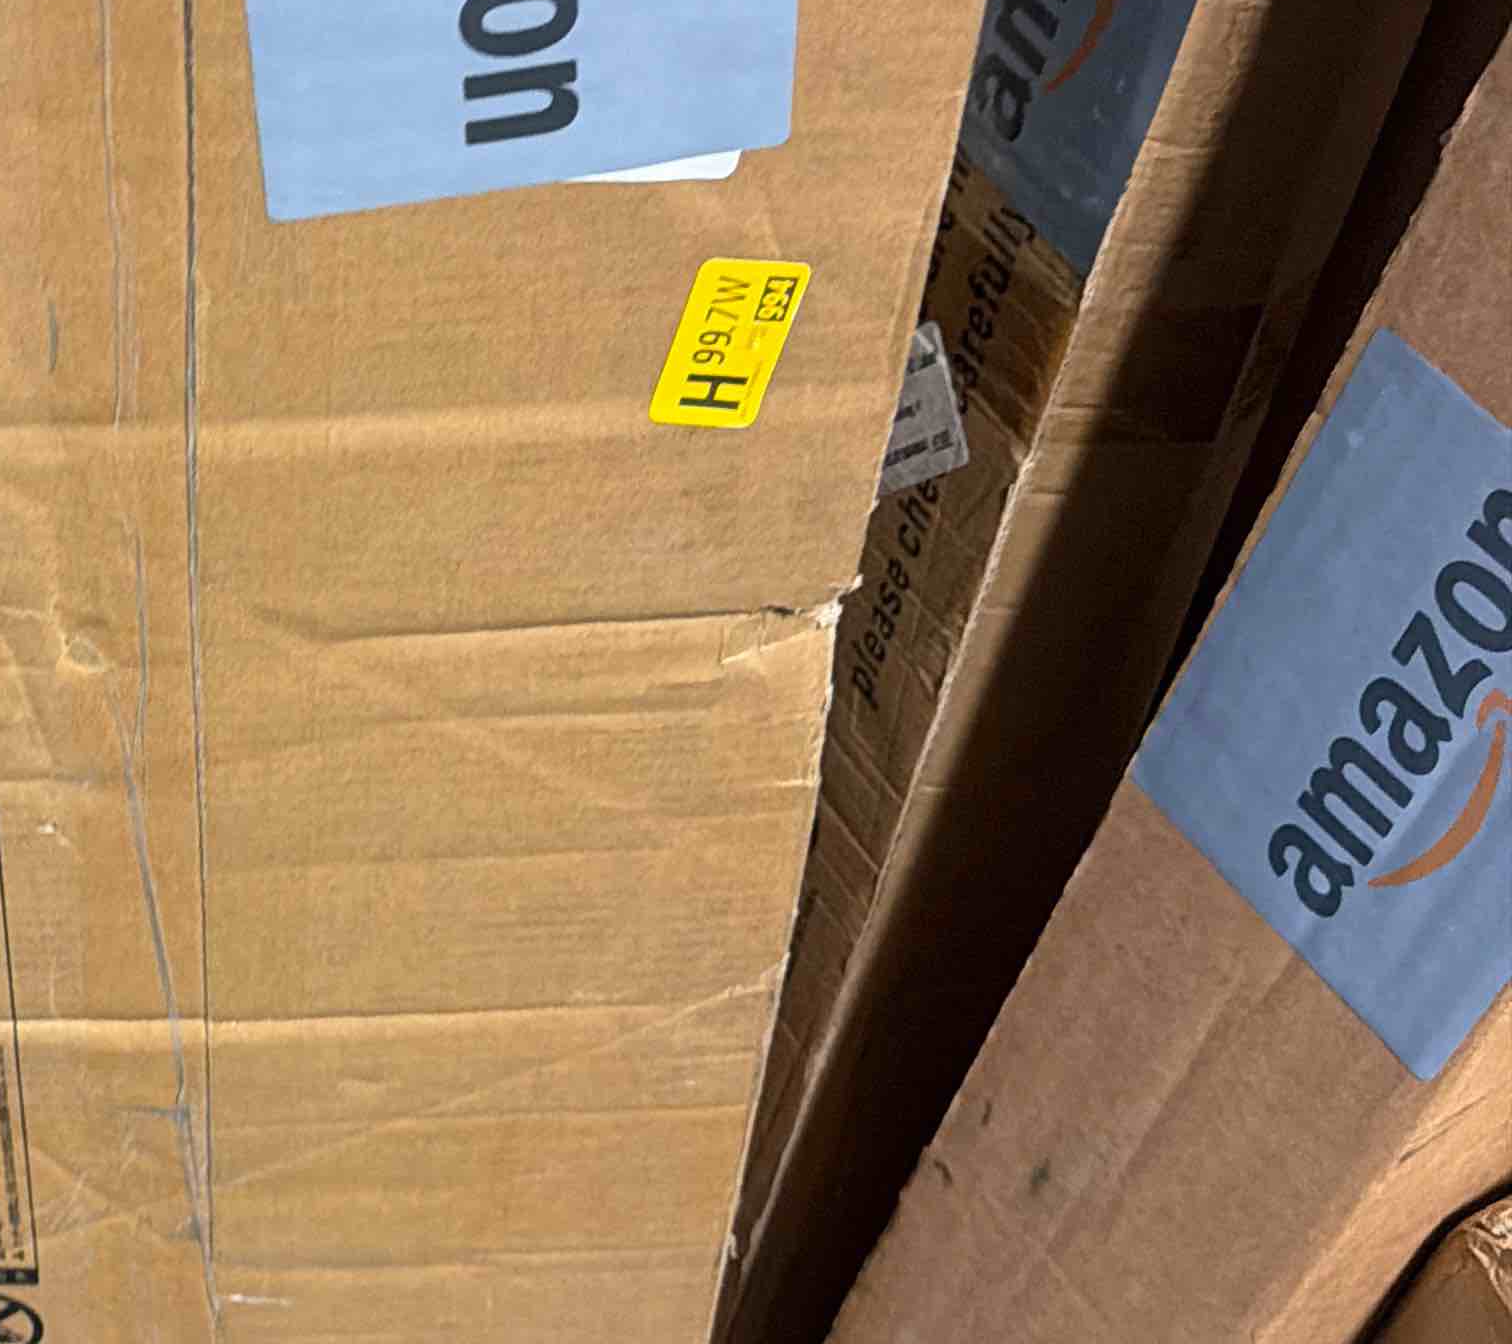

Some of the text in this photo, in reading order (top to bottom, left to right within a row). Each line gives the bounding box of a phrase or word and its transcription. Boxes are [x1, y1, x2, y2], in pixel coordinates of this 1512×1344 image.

[678, 373, 749, 411] H
[851, 557, 910, 710] please
[898, 478, 939, 558] che
